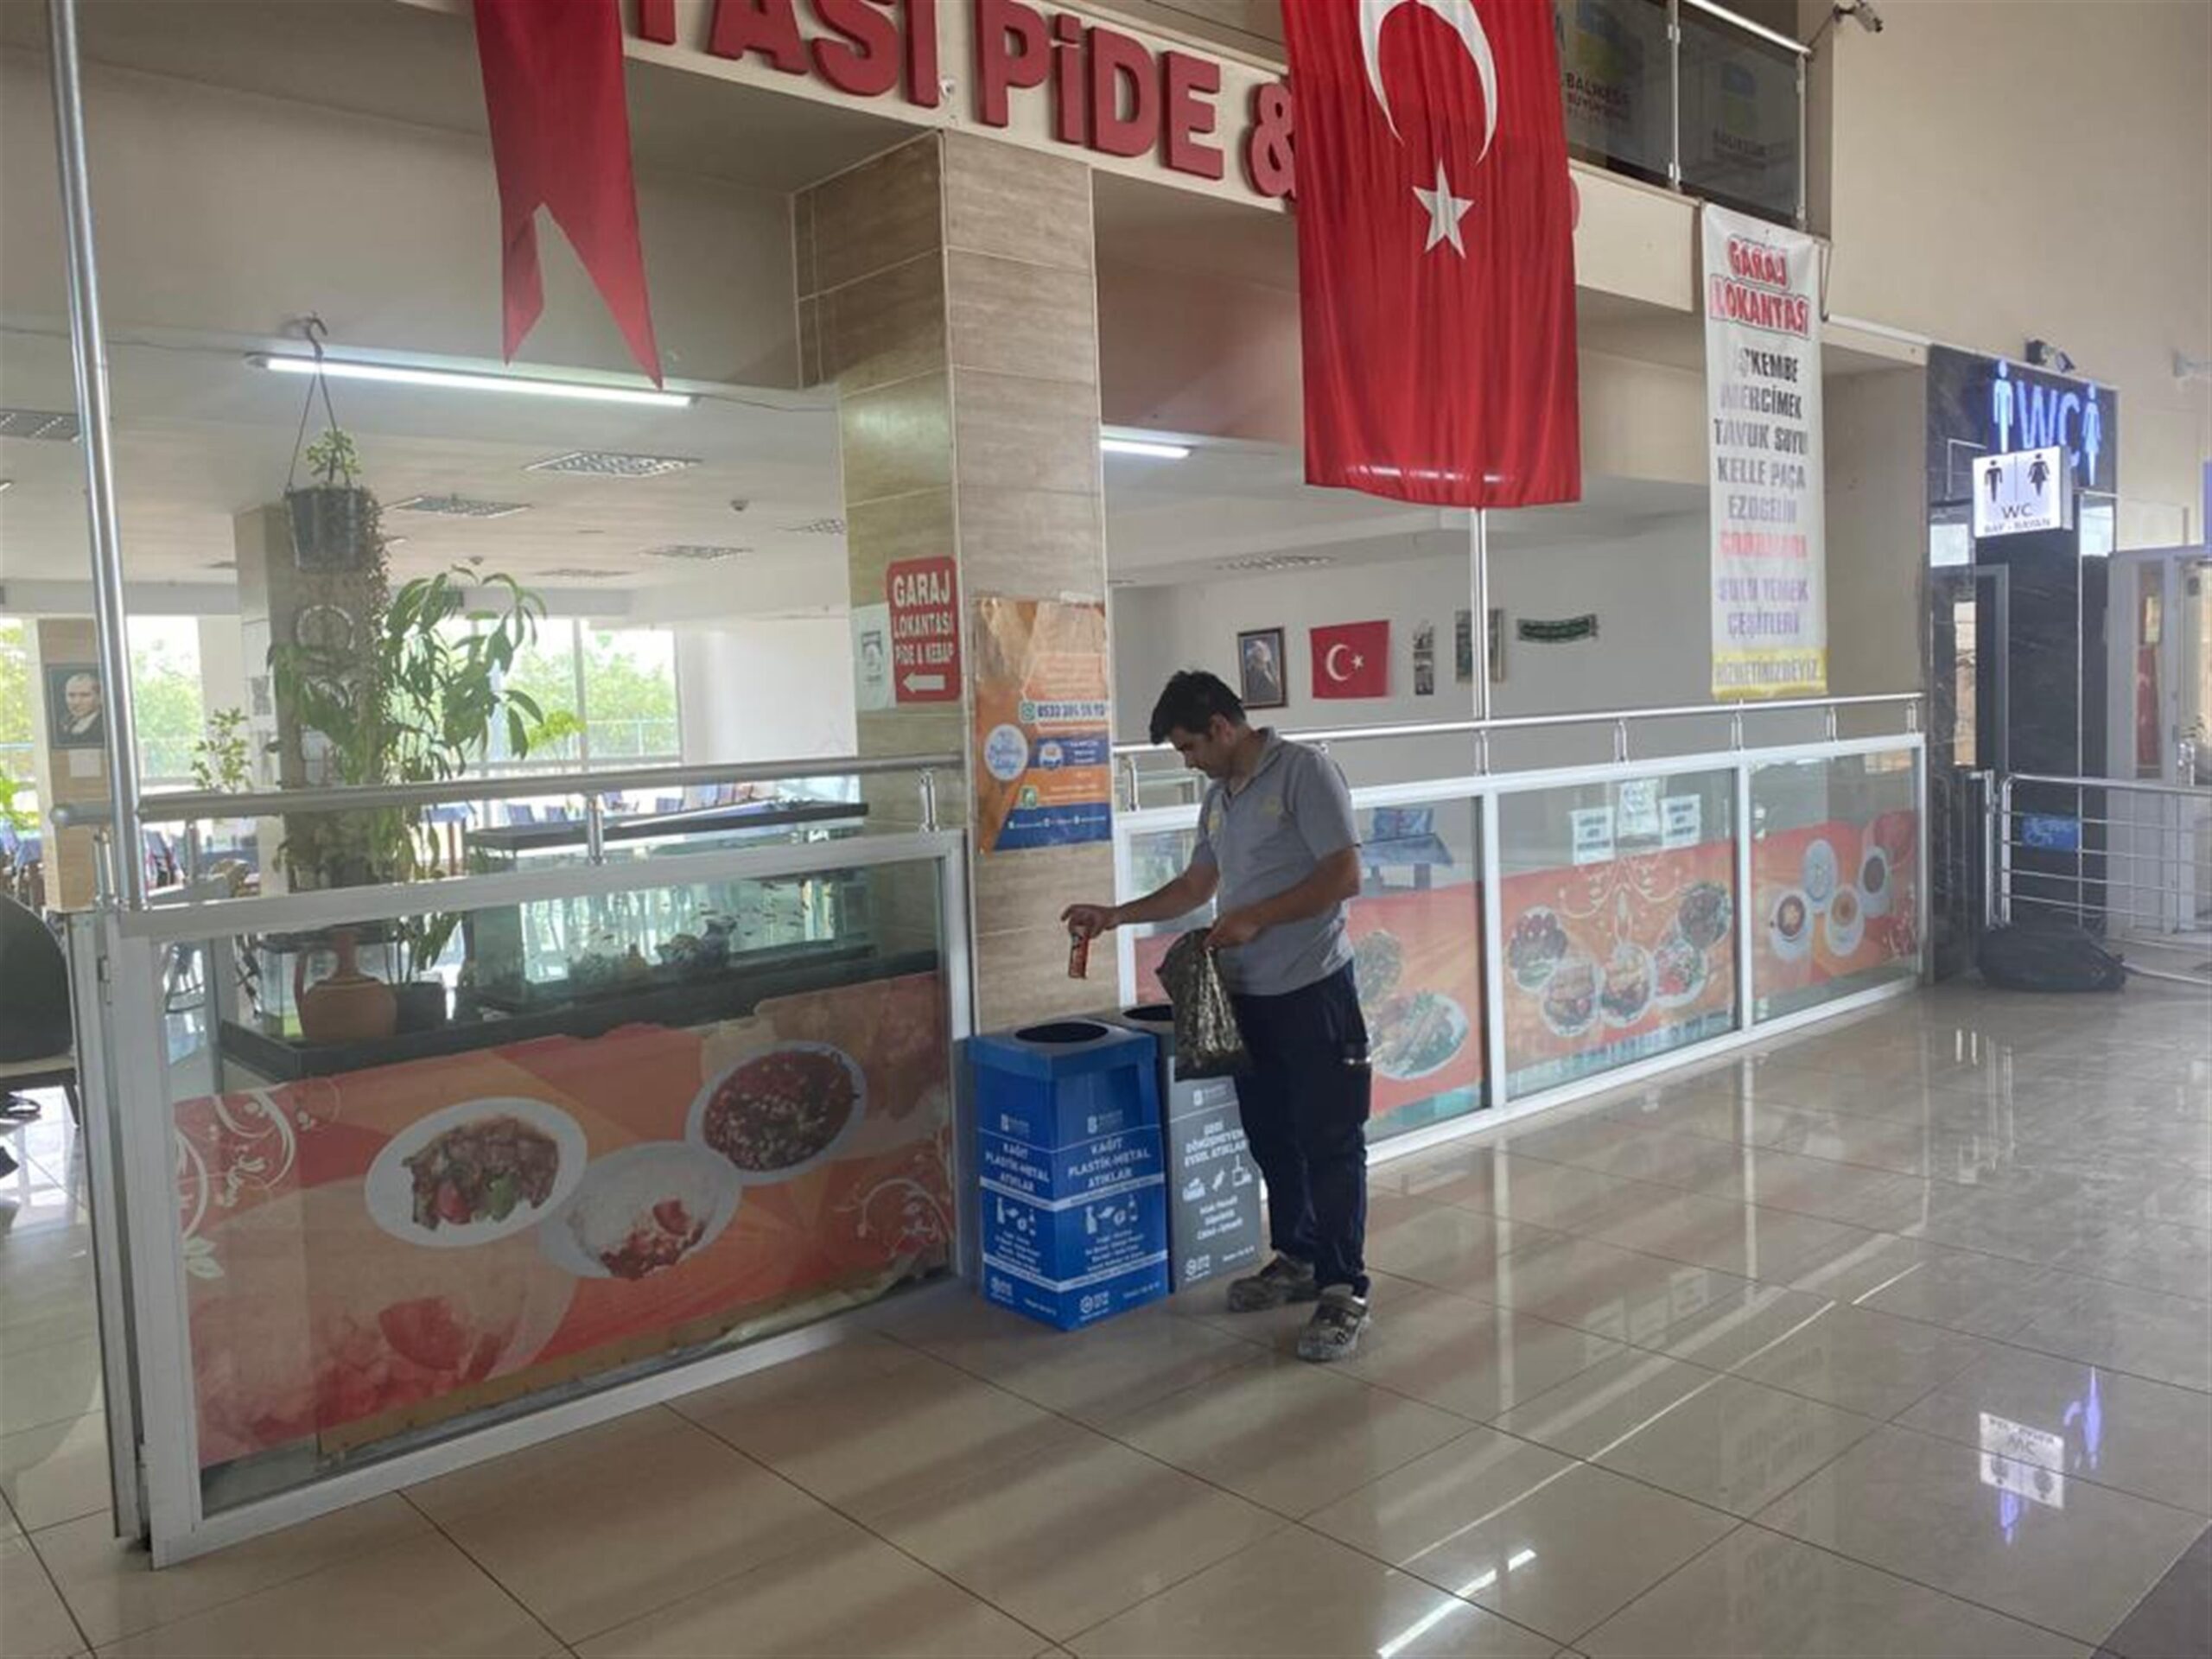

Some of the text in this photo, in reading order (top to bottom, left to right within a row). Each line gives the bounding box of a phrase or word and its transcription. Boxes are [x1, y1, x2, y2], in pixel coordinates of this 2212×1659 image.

[1727, 238, 1788, 288] GARAJ
[1712, 278, 1808, 336] LOKANTASI
[1713, 417, 1770, 450] TAVUK
[1717, 456, 1766, 486] KELLE
[2001, 503, 2033, 518] WC
[894, 570, 950, 607] GARAJ
